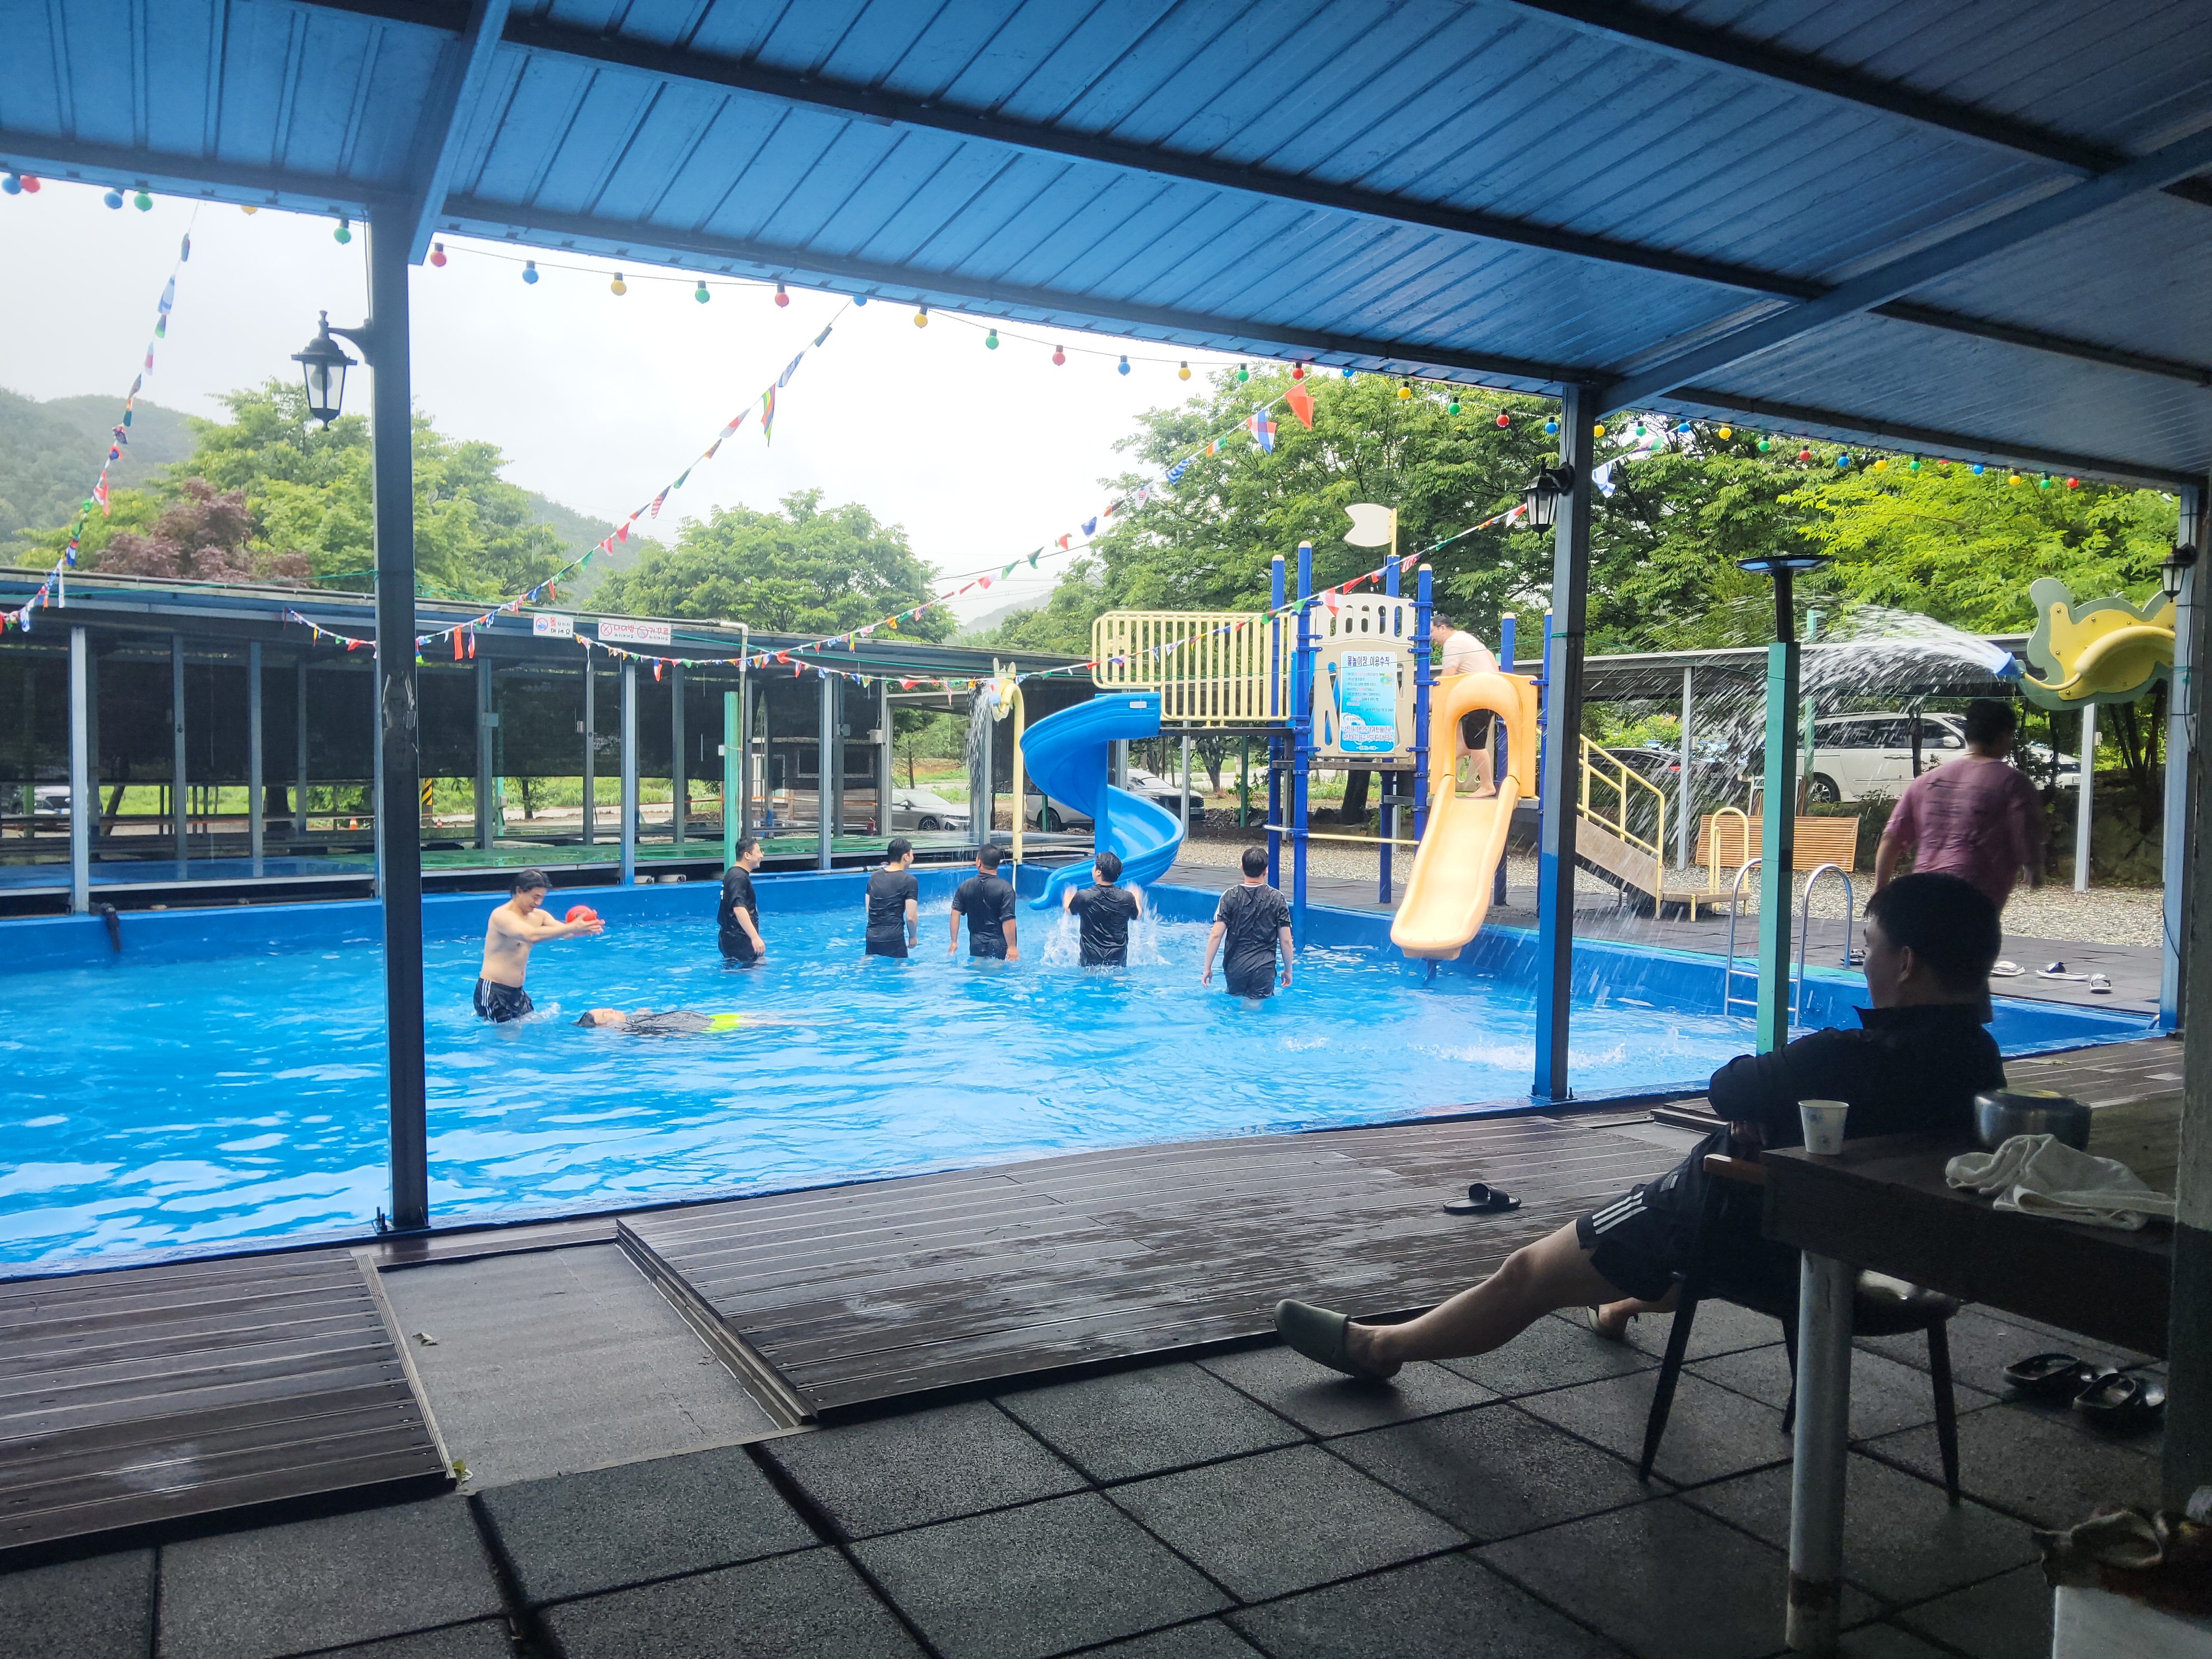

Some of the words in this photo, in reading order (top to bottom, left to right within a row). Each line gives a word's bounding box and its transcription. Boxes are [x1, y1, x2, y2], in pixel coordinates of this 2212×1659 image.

[614, 624, 634, 633] 다이빙
[648, 627, 668, 635] 거꾸로
[1347, 655, 1367, 667] 물놀이장
[1369, 655, 1390, 667] 이용수칙
